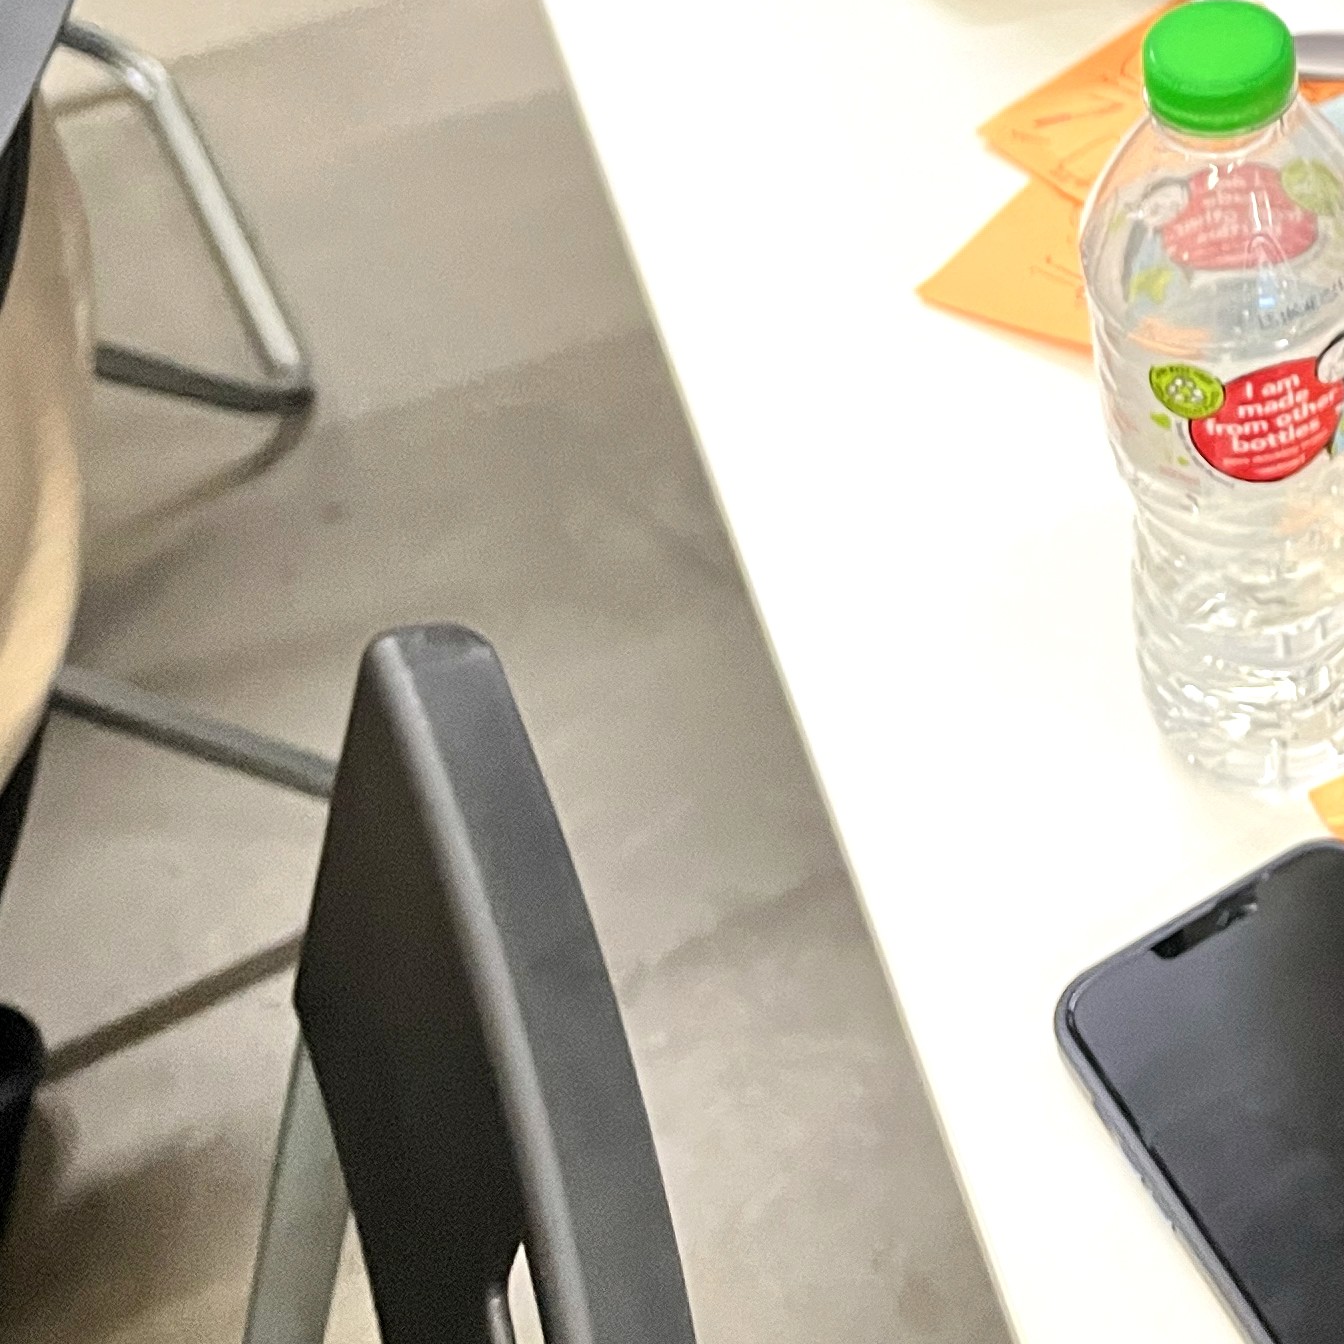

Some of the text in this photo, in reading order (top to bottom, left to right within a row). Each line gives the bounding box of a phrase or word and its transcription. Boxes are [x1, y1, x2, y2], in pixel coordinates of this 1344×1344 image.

[1244, 373, 1300, 399] I am
[1204, 387, 1337, 436] from other
[1237, 388, 1309, 418] made
[1231, 418, 1320, 453] bottles
